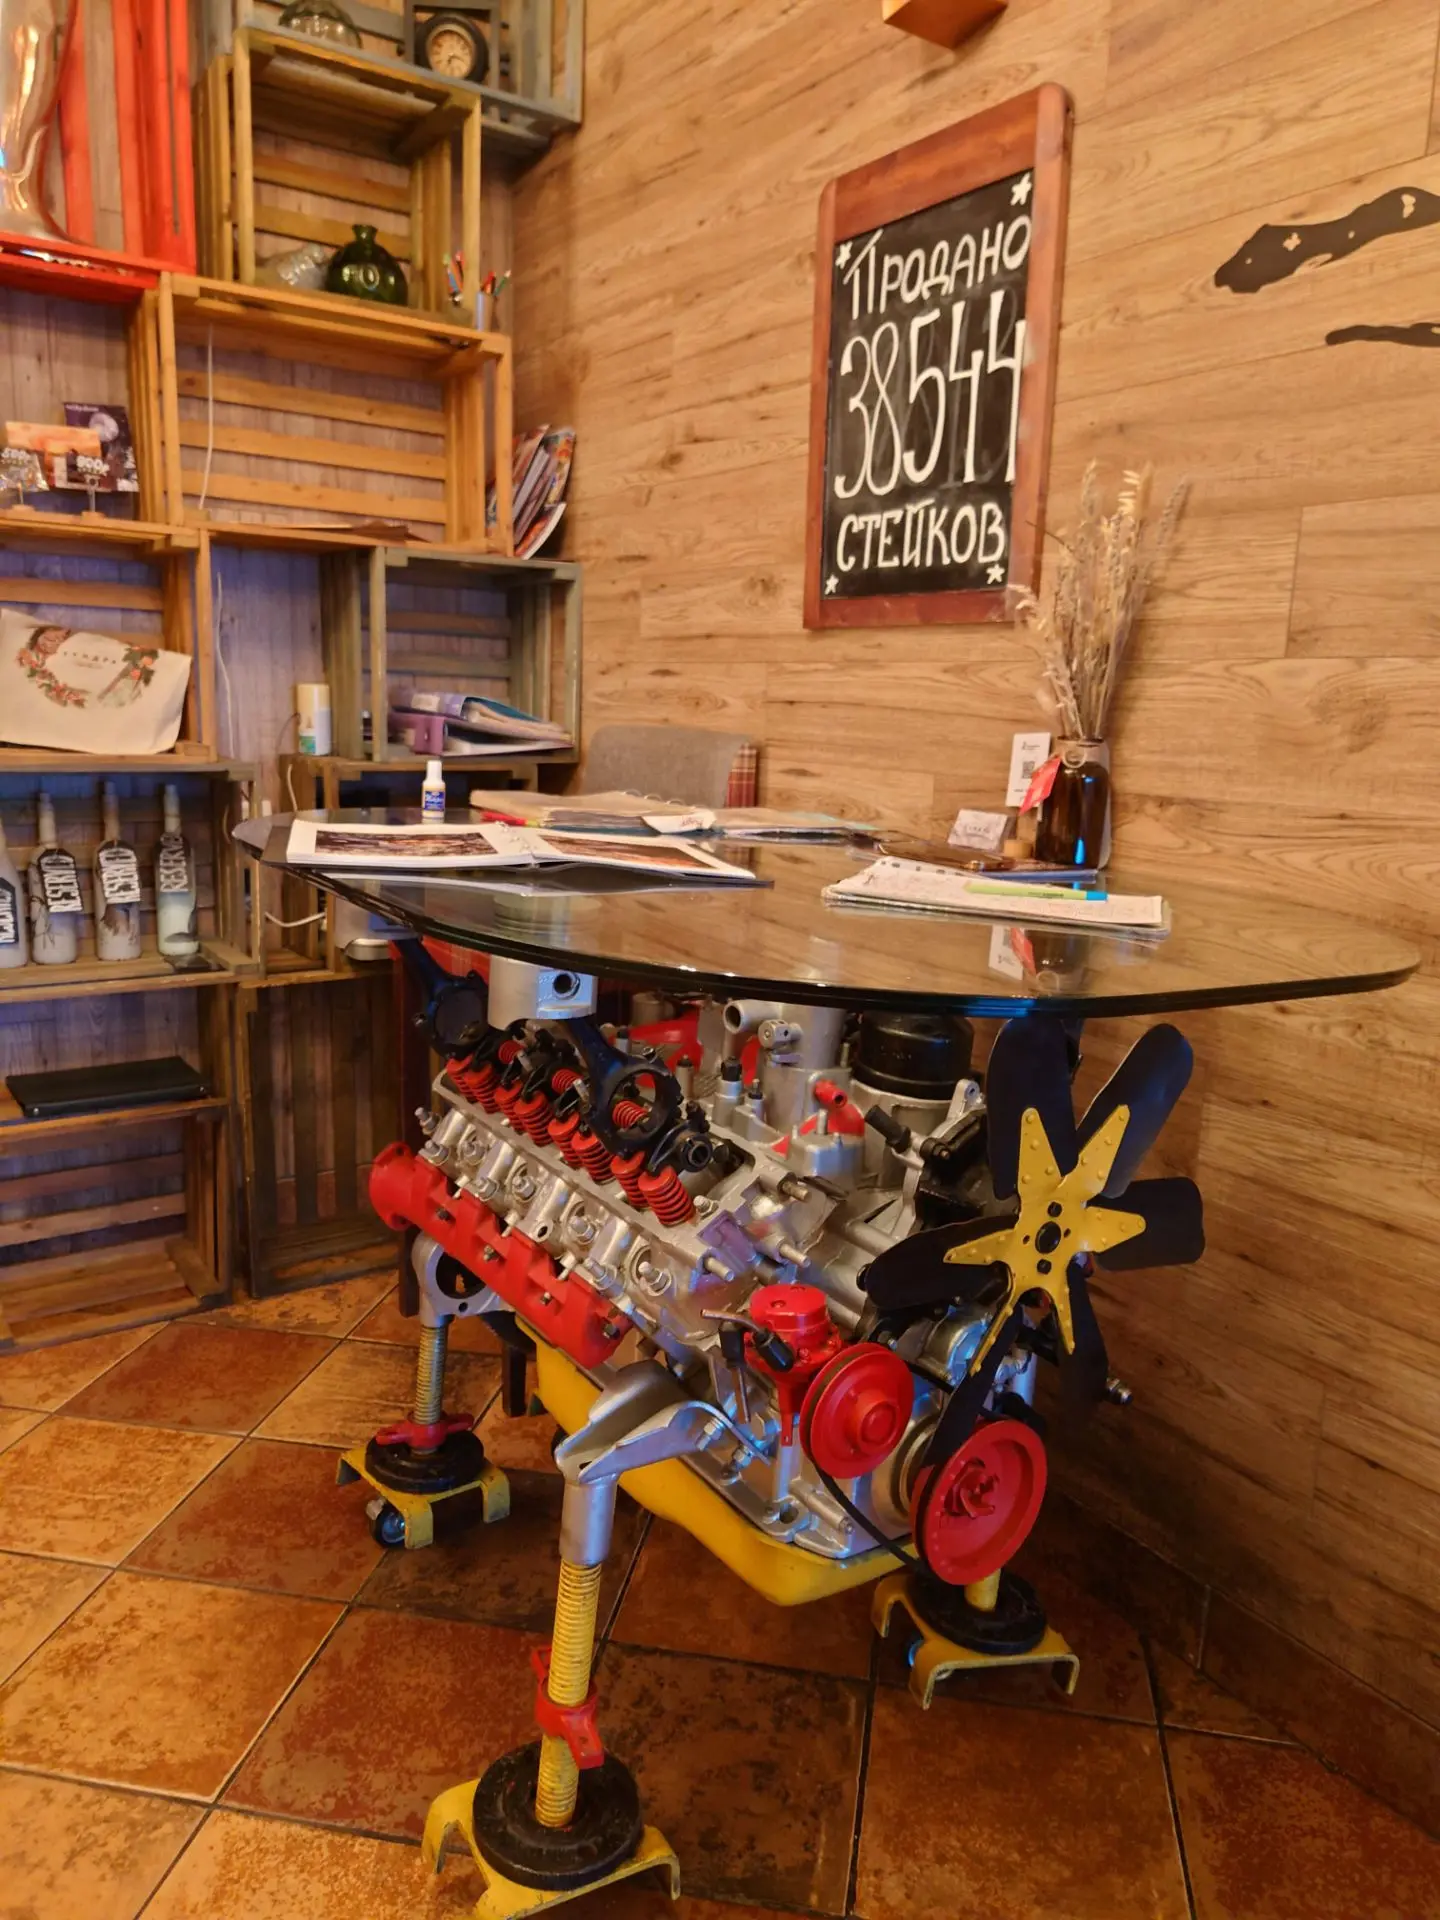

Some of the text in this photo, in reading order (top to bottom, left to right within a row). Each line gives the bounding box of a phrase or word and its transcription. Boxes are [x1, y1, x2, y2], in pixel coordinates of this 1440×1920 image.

[843, 215, 1032, 320] ПРОДАНО
[834, 289, 1027, 499] 38544
[835, 498, 1006, 572] СТЕЙКОВ
[41, 855, 82, 912] RESERVED
